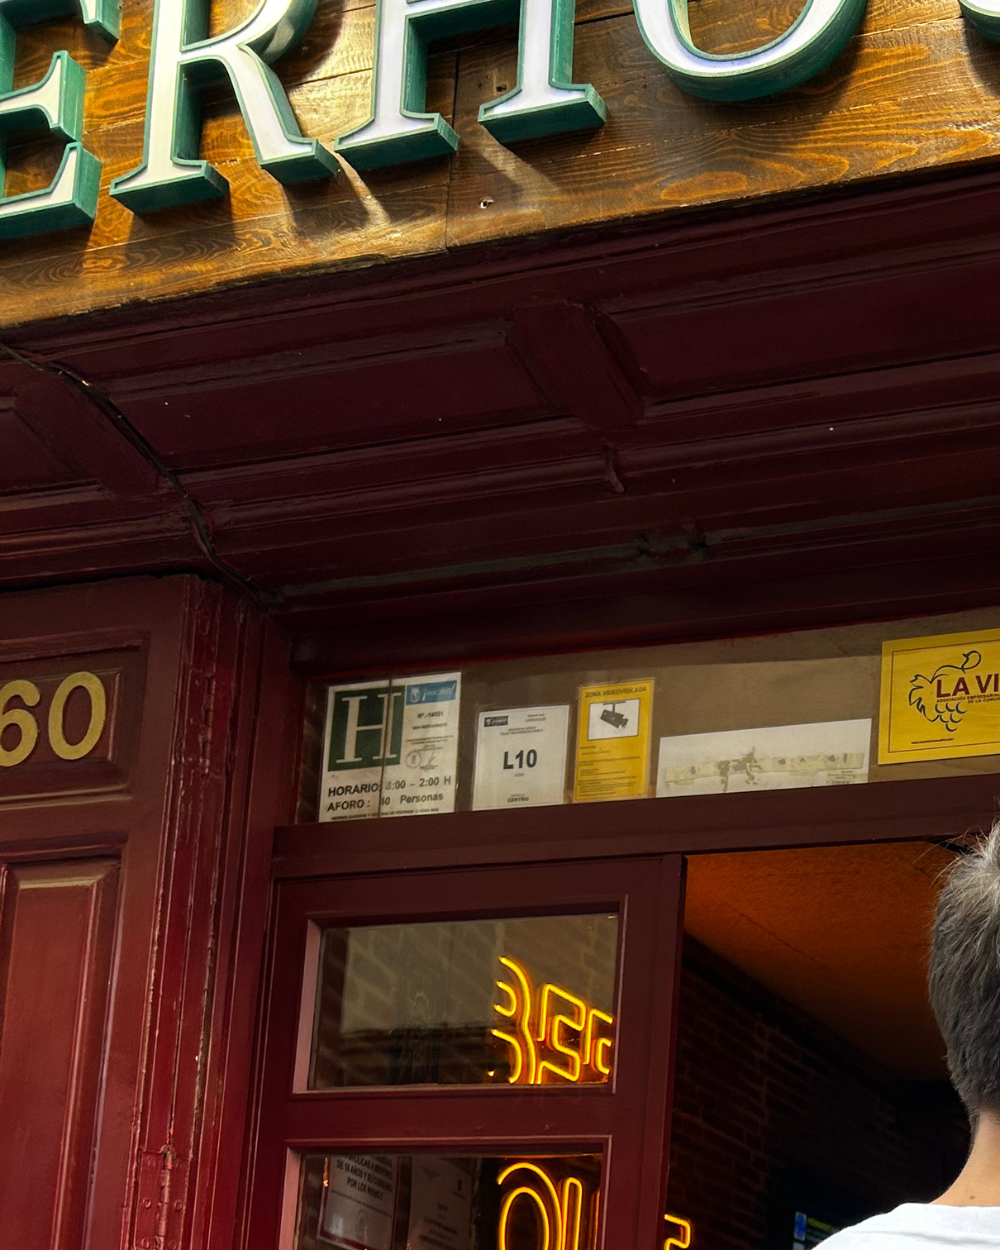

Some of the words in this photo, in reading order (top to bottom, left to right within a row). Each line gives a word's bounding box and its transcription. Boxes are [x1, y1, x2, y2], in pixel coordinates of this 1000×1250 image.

[936, 677, 970, 698] LA
[336, 692, 402, 764] H
[503, 749, 537, 770] L10
[419, 776, 440, 788] 2:00
[443, 775, 452, 786] H
[400, 792, 443, 804] Personas
